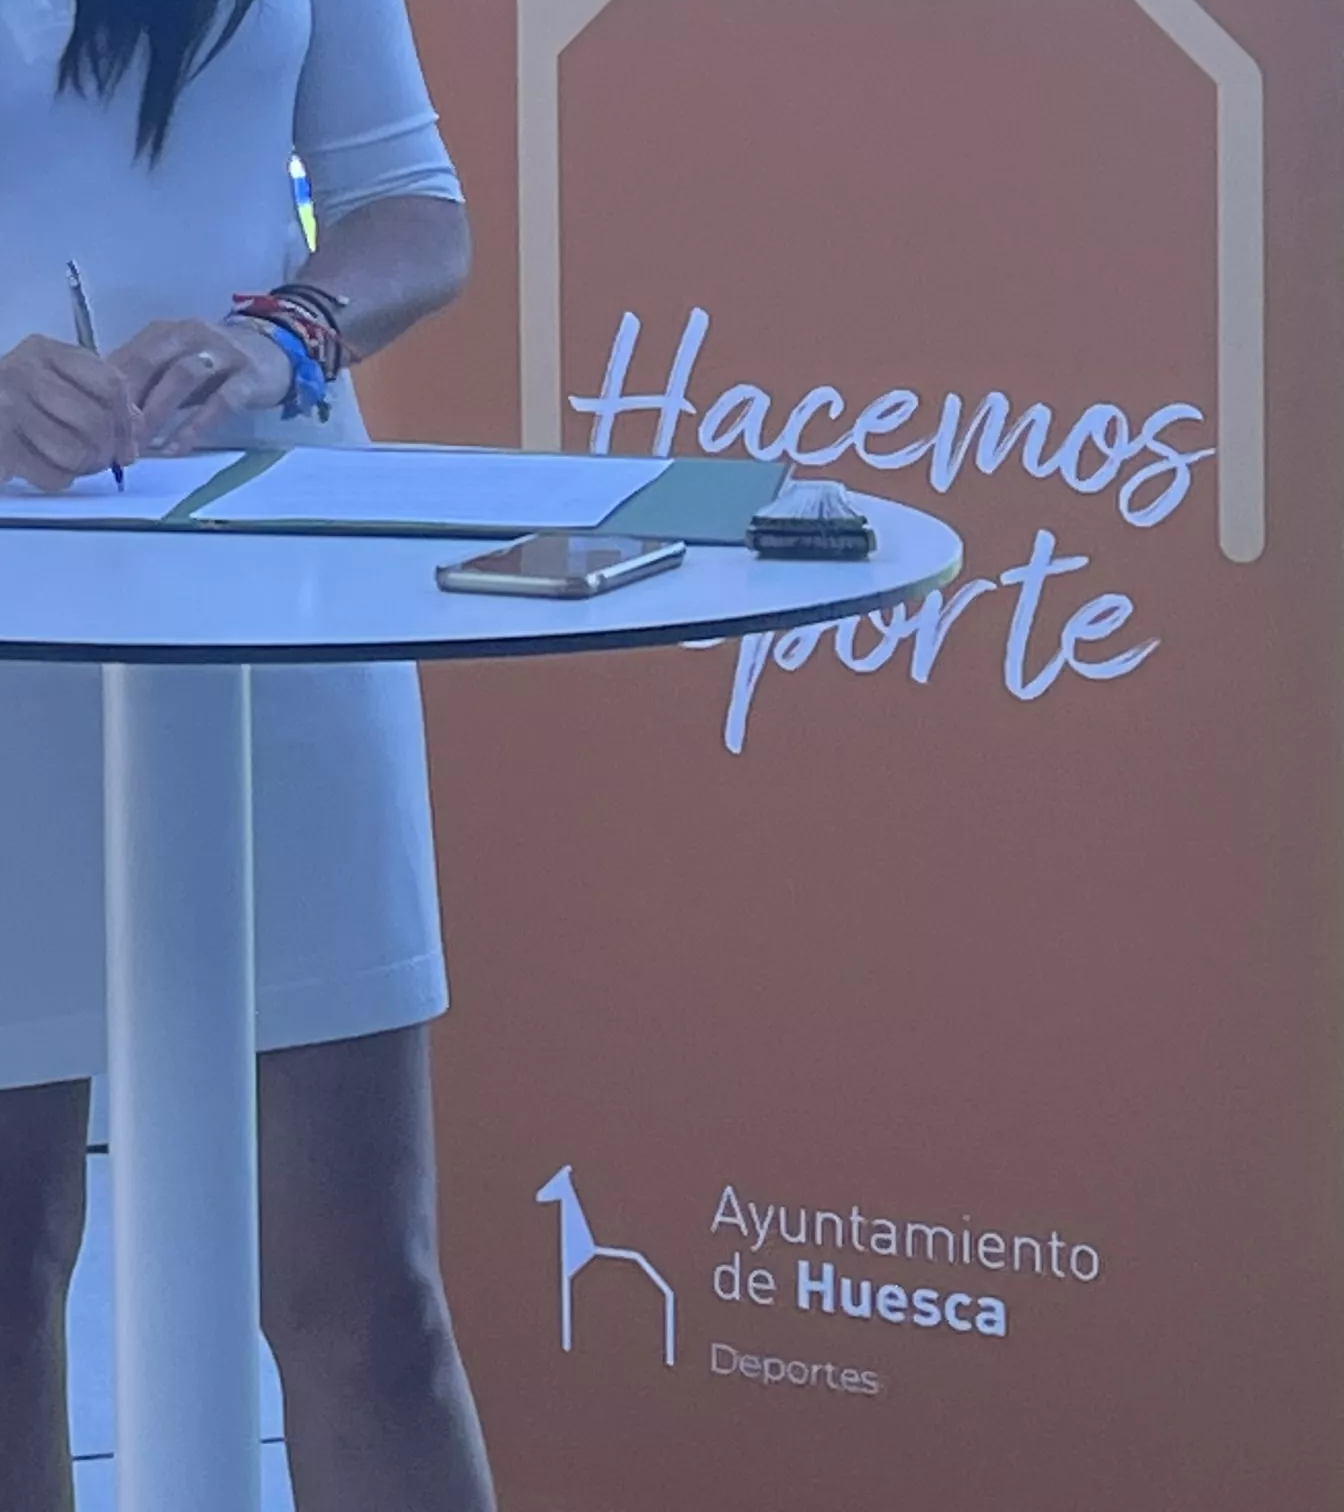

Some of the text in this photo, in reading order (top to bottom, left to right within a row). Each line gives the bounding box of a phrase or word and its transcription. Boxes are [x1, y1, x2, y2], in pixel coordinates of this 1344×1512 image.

[569, 308, 1215, 528] Hacemos
[679, 530, 1161, 755] porte
[710, 1185, 1100, 1282] Ayuntamiento
[713, 1252, 1007, 1337] de Huesca
[712, 1342, 879, 1395] Deportes
